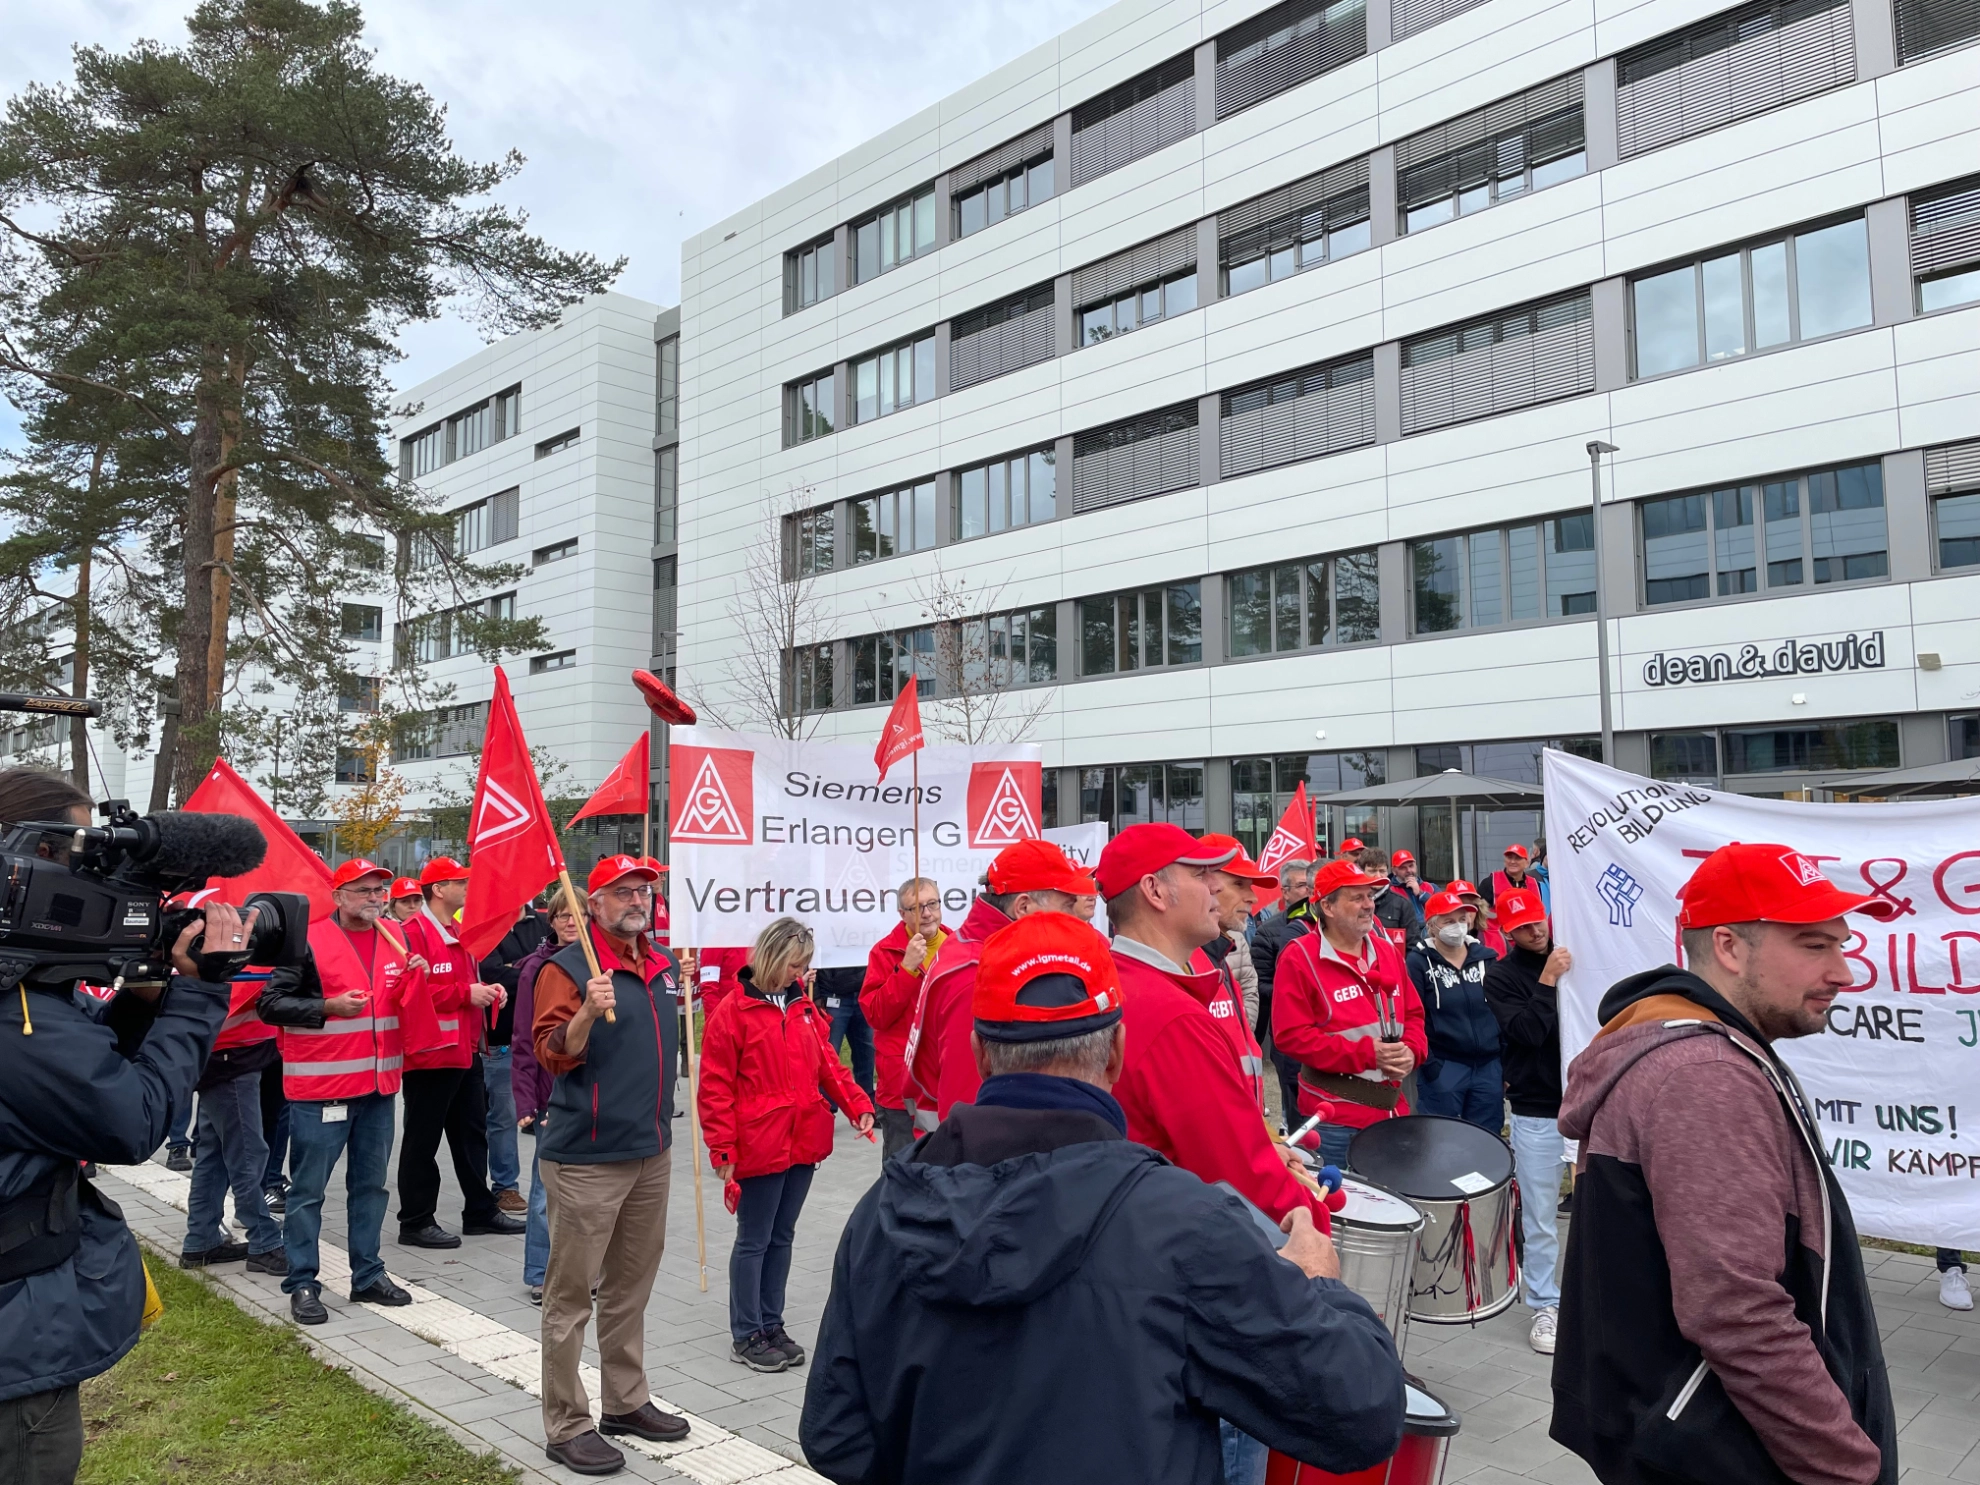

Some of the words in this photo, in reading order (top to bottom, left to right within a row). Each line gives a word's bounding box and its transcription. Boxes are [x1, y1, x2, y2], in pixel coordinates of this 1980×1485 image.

[784, 770, 943, 805] Siemens
[761, 815, 917, 853] Erlangen
[1826, 1004, 1925, 1043] CARE
[1814, 1097, 1863, 1125] MIT
[1874, 1104, 1959, 1140] UNS!
